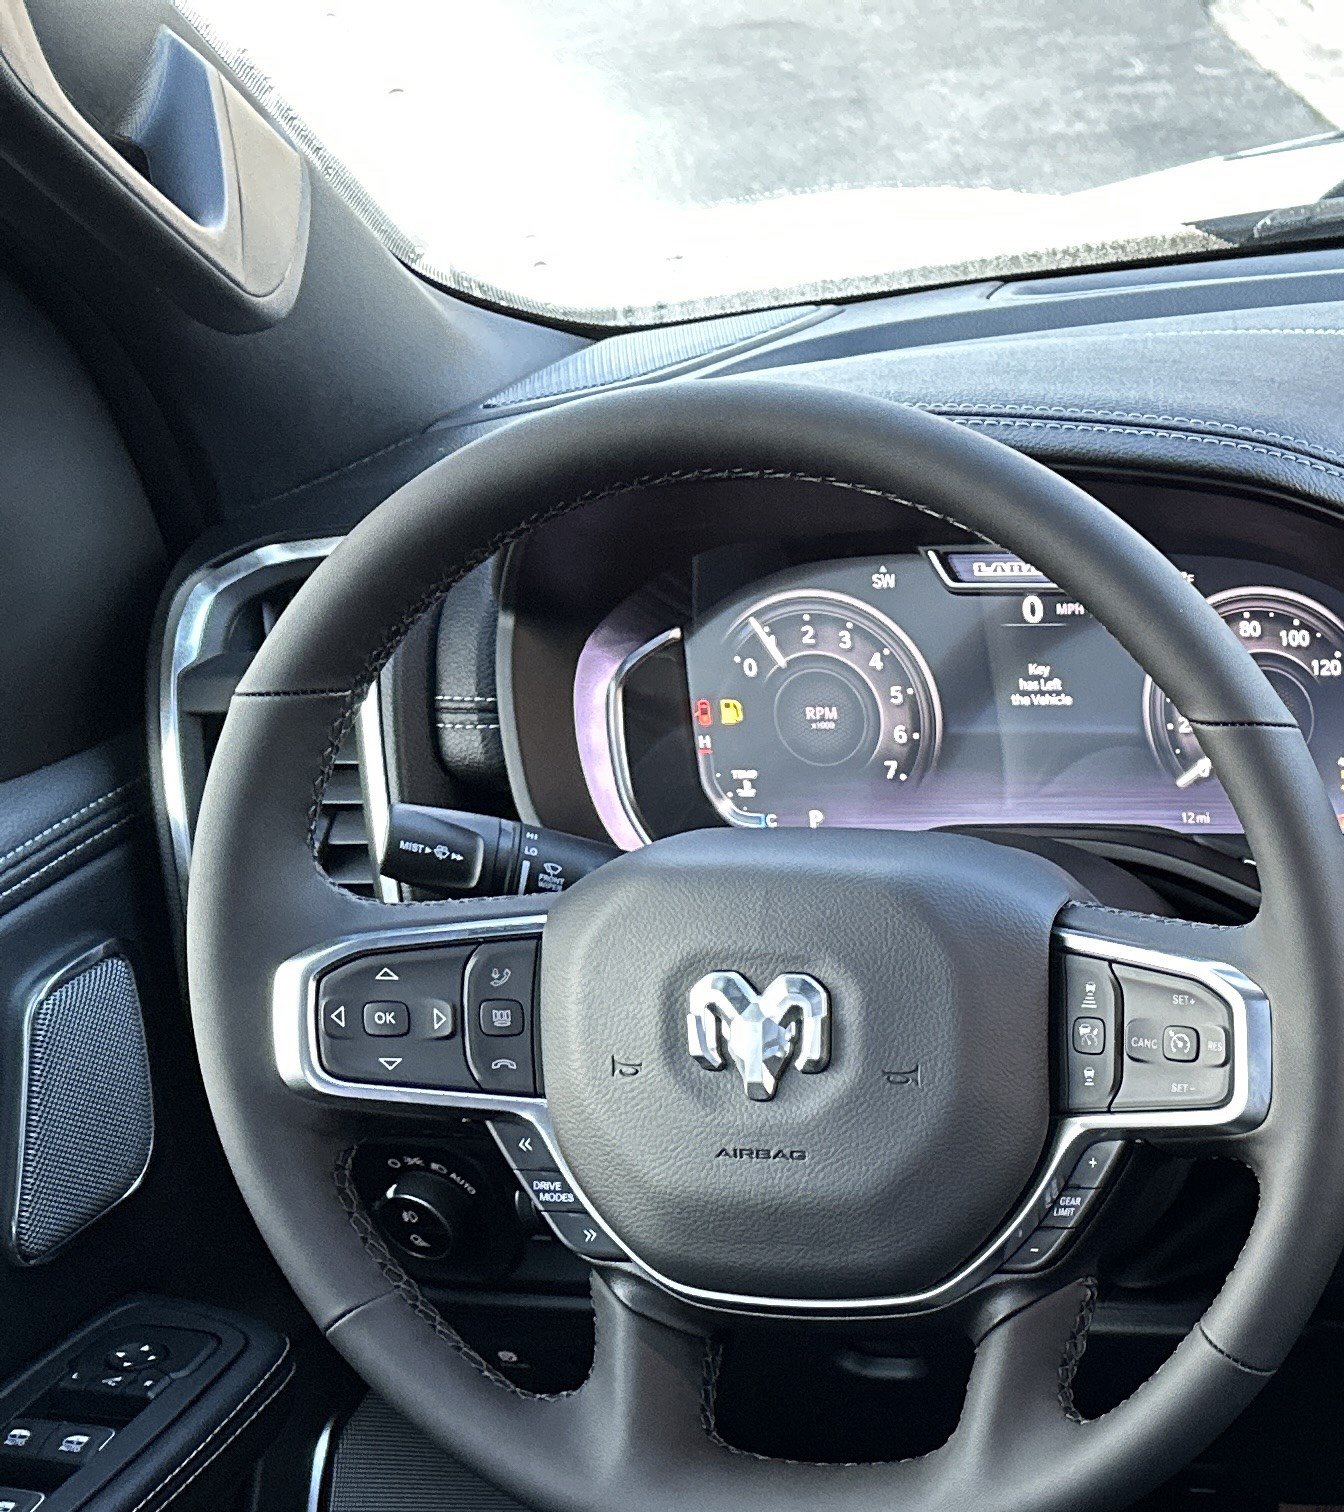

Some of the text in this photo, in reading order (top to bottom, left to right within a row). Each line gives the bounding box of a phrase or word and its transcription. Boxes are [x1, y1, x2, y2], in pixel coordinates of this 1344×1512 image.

[872, 574, 895, 589] SW
[1022, 595, 1084, 623] 0 MPH
[801, 625, 815, 644] 2
[1239, 621, 1261, 637] 80
[839, 630, 851, 649] 3
[1280, 630, 1309, 647] 100
[743, 658, 757, 677] 0
[869, 652, 883, 671] 4
[1311, 659, 1341, 676] 120
[1028, 664, 1050, 677] Key
[1019, 678, 1062, 691] has Left
[890, 686, 903, 705] 5
[1011, 694, 1073, 705] the Vehicle
[806, 707, 837, 720] RPM
[699, 736, 711, 748] H
[894, 726, 907, 744] 6
[884, 761, 898, 780] 7
[766, 814, 777, 827] C
[809, 810, 823, 828] P
[400, 840, 425, 853] MIST
[524, 846, 538, 856] LO
[374, 1010, 396, 1025] OK
[1131, 1037, 1158, 1049] CANC
[714, 1147, 808, 1161] AIRBAG
[533, 1181, 562, 1191] DRIVE
[539, 1193, 574, 1203] MODES
[1060, 1197, 1081, 1206] GEAR
[1054, 1208, 1075, 1216] LIMIT
